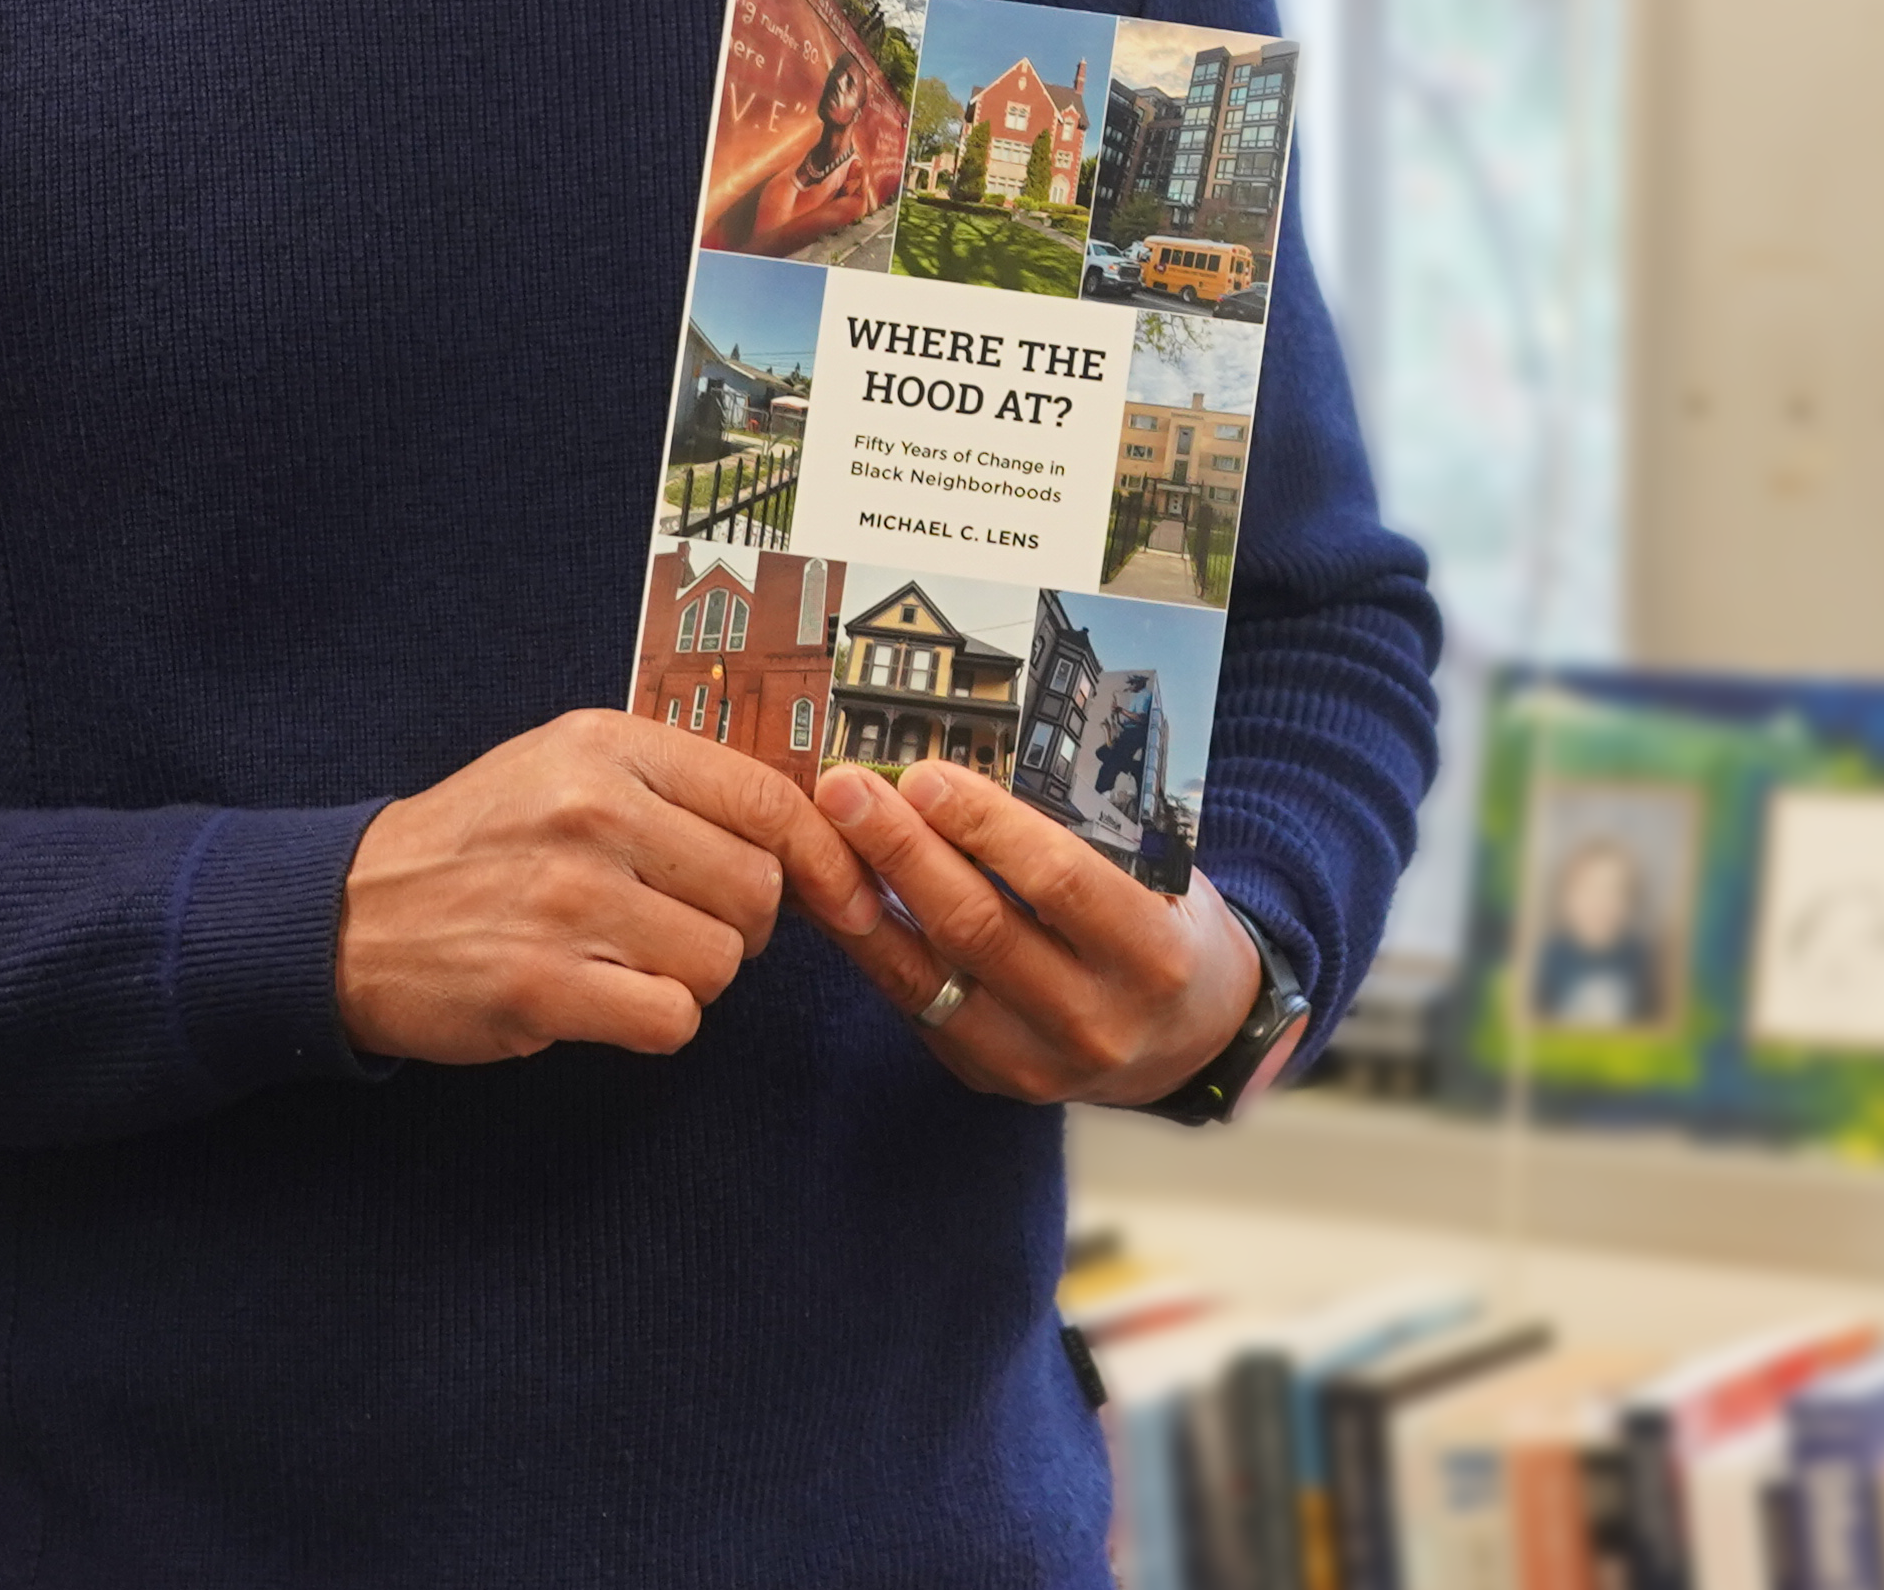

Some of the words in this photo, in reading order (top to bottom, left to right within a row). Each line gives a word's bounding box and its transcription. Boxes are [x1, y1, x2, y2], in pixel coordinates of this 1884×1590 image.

[760, 12, 800, 52] number
[802, 39, 819, 65] 80
[846, 315, 1004, 368] WHERE
[1018, 339, 1107, 383] THE
[861, 369, 985, 416] HOOD
[994, 388, 1074, 428] AT?
[853, 434, 896, 456] Fifty
[901, 440, 948, 461] Years
[953, 448, 972, 464] of
[977, 451, 1045, 476] Change
[1049, 459, 1066, 477] in
[850, 460, 904, 483] Black
[909, 469, 1063, 504] Neighborhoods
[858, 510, 953, 539] MICHAEL
[959, 525, 980, 543] C.
[986, 527, 1040, 550] LENS
